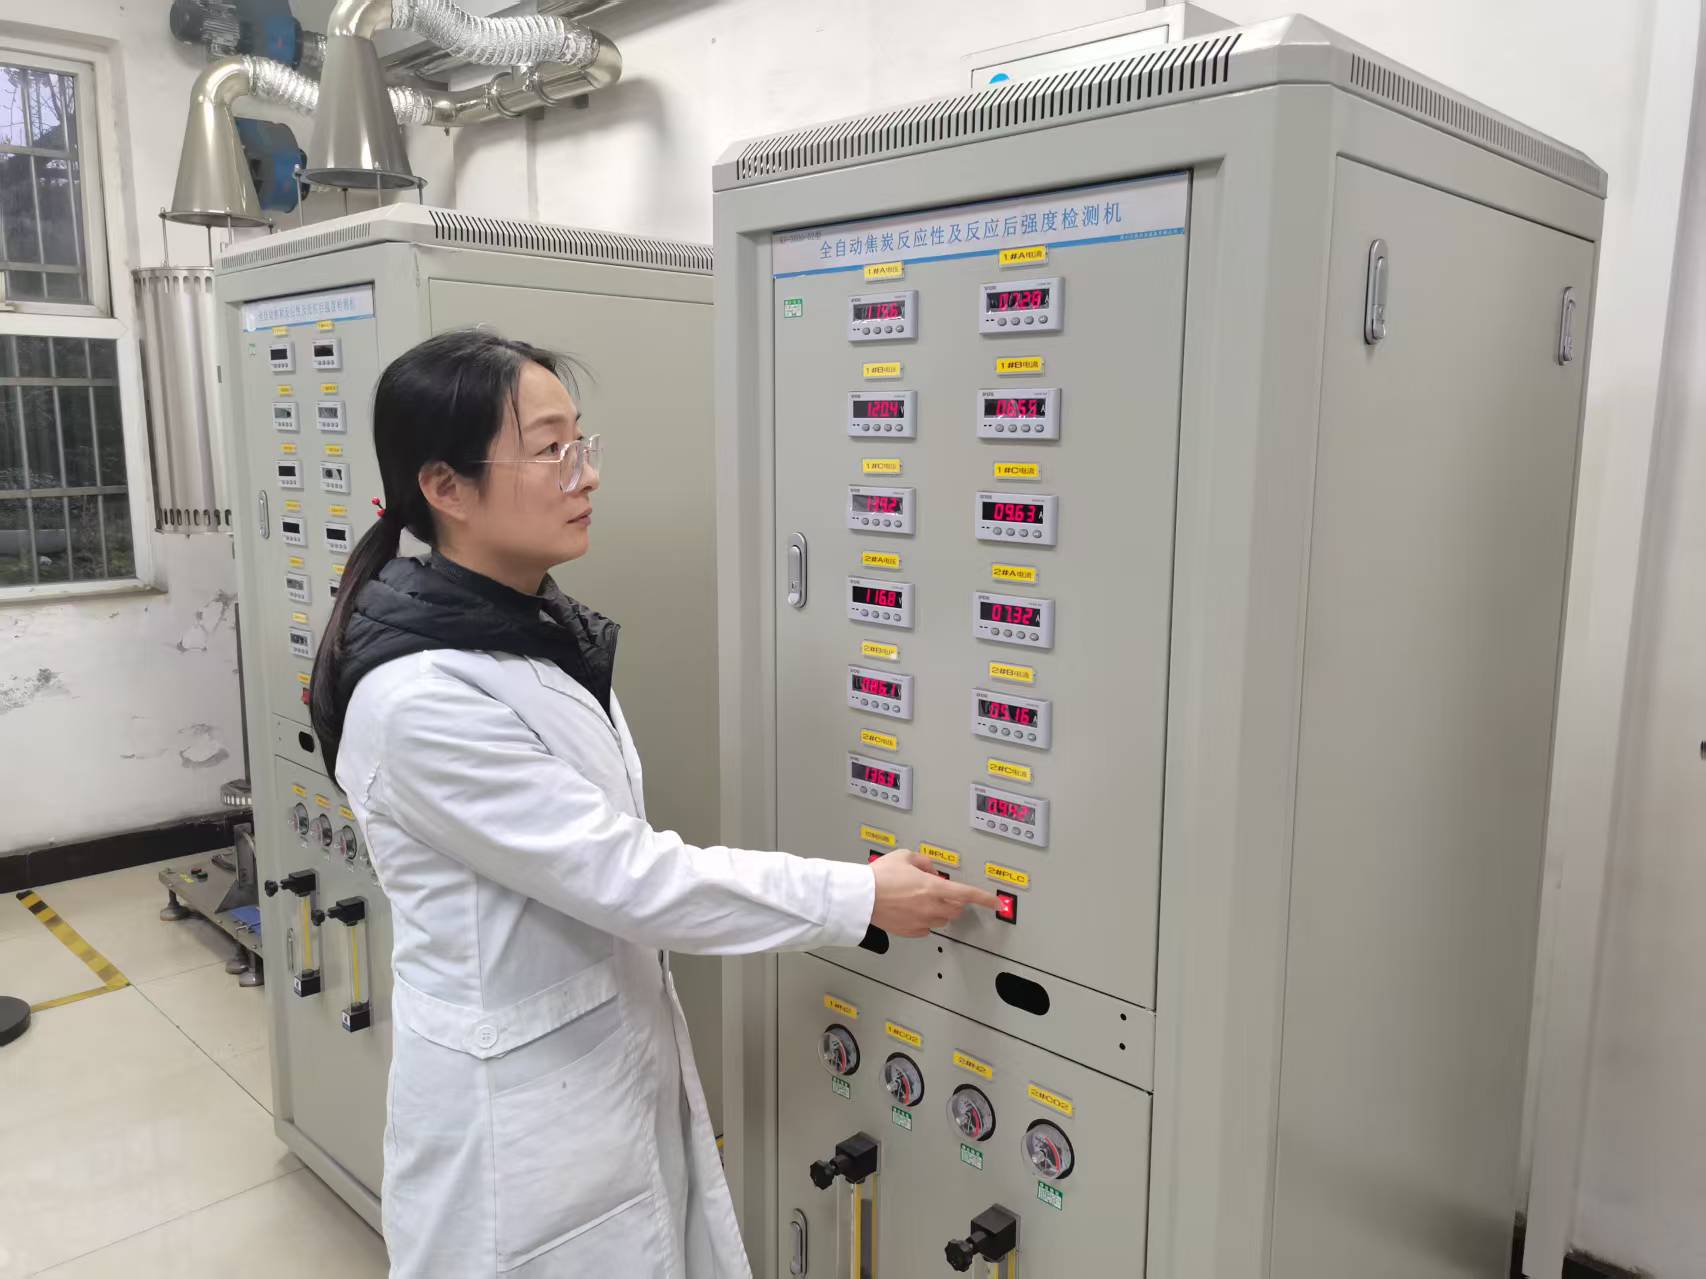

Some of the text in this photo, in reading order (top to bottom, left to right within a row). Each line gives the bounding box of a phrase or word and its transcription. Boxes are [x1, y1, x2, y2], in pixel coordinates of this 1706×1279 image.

[820, 202, 1122, 259] 全自动焦炭反应性及反应后强度检测机
[924, 847, 956, 862] 1#PLC
[987, 866, 1025, 883] 2#PLC
